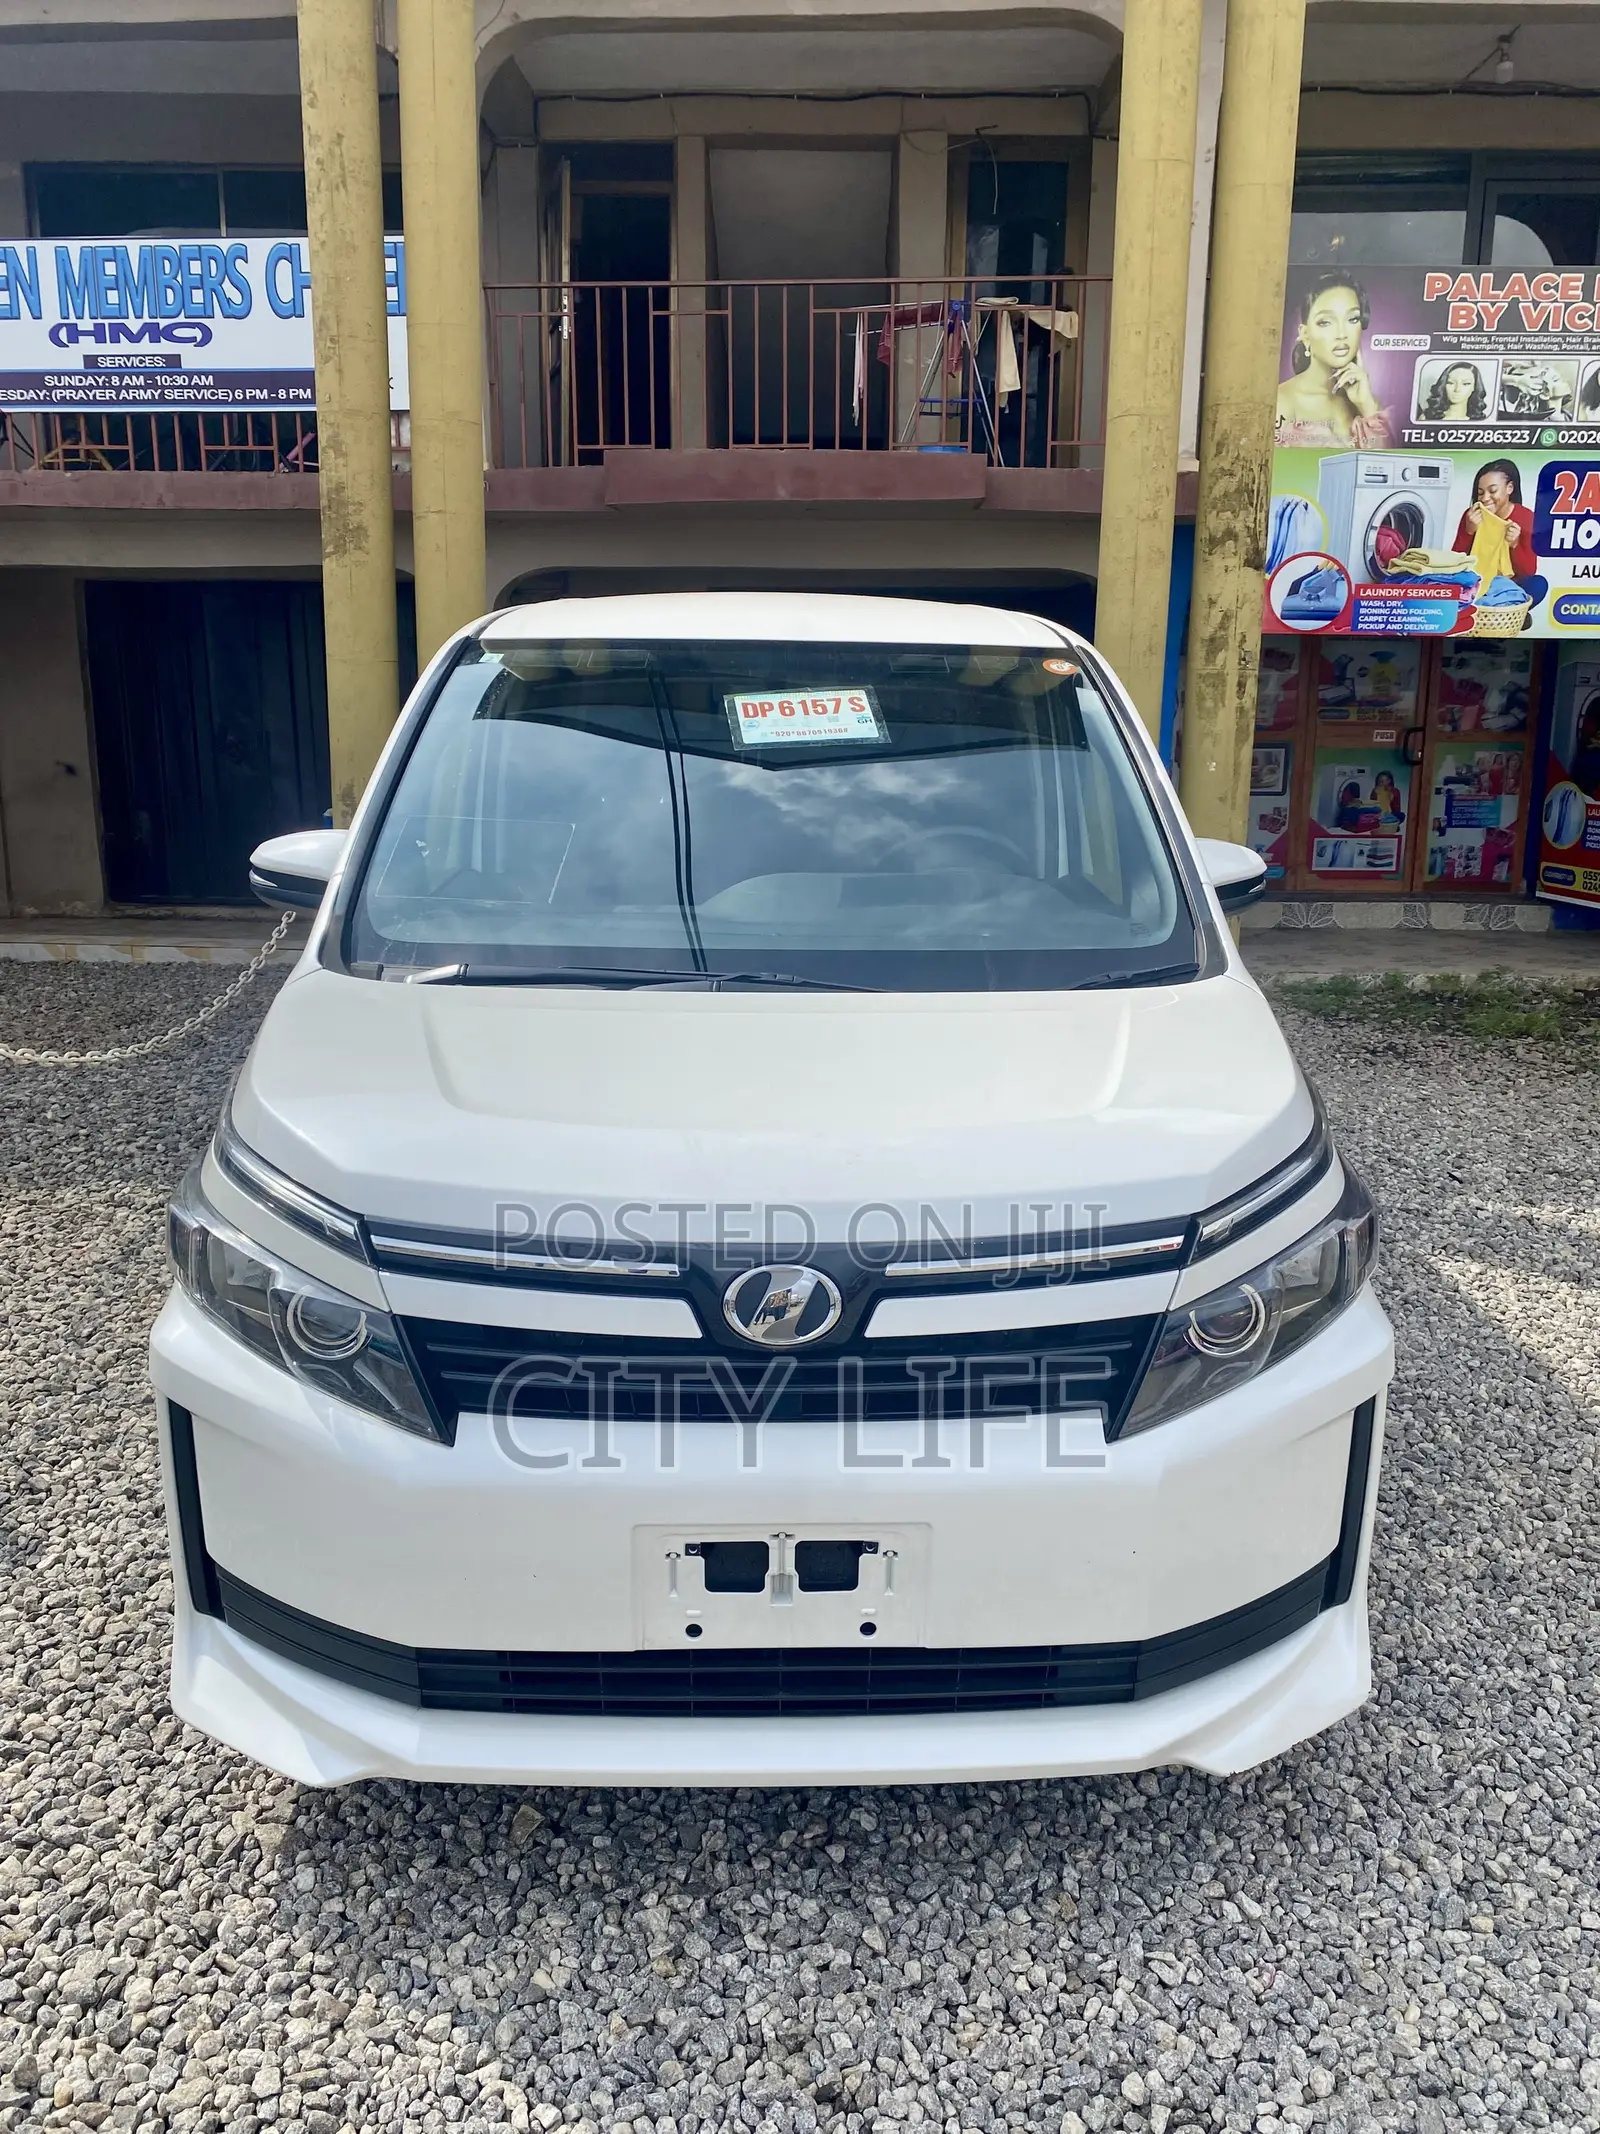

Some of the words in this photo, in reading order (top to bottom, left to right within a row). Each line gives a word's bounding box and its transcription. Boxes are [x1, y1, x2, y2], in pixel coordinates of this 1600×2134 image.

[54, 243, 253, 319] MEMBERS
[1424, 273, 1584, 301] PALACE
[1448, 302, 1508, 331] BY
[1519, 302, 1600, 331] VIC
[48, 322, 213, 347] (HMC)
[1373, 338, 1390, 347] OUR
[1391, 338, 1428, 347] SERVICES
[1525, 343, 1560, 351] Washing,
[97, 356, 166, 368] SERVICES:
[44, 375, 109, 386] SUNDAY:
[111, 375, 120, 386] 8
[122, 375, 145, 386] AM
[155, 375, 188, 386] 10:30
[191, 375, 214, 386] AM
[52, 389, 116, 402] (PRAYER
[119, 389, 162, 400] ARMY
[164, 388, 233, 402] SERVICE)
[235, 389, 243, 400] 6
[246, 388, 268, 400] PM
[278, 388, 286, 400] 8
[289, 388, 312, 400] PM
[1402, 429, 1435, 443] TEL:
[1437, 430, 1530, 443] 0257286323
[1360, 588, 1407, 597] LAUNDRY
[1407, 589, 1452, 597] SERVICES
[1360, 600, 1385, 608] WASH,
[1386, 600, 1404, 608] DRY,
[1409, 608, 1444, 616] FOLDING,
[742, 701, 774, 718] DP
[778, 697, 842, 717] 6157
[848, 696, 866, 713] S
